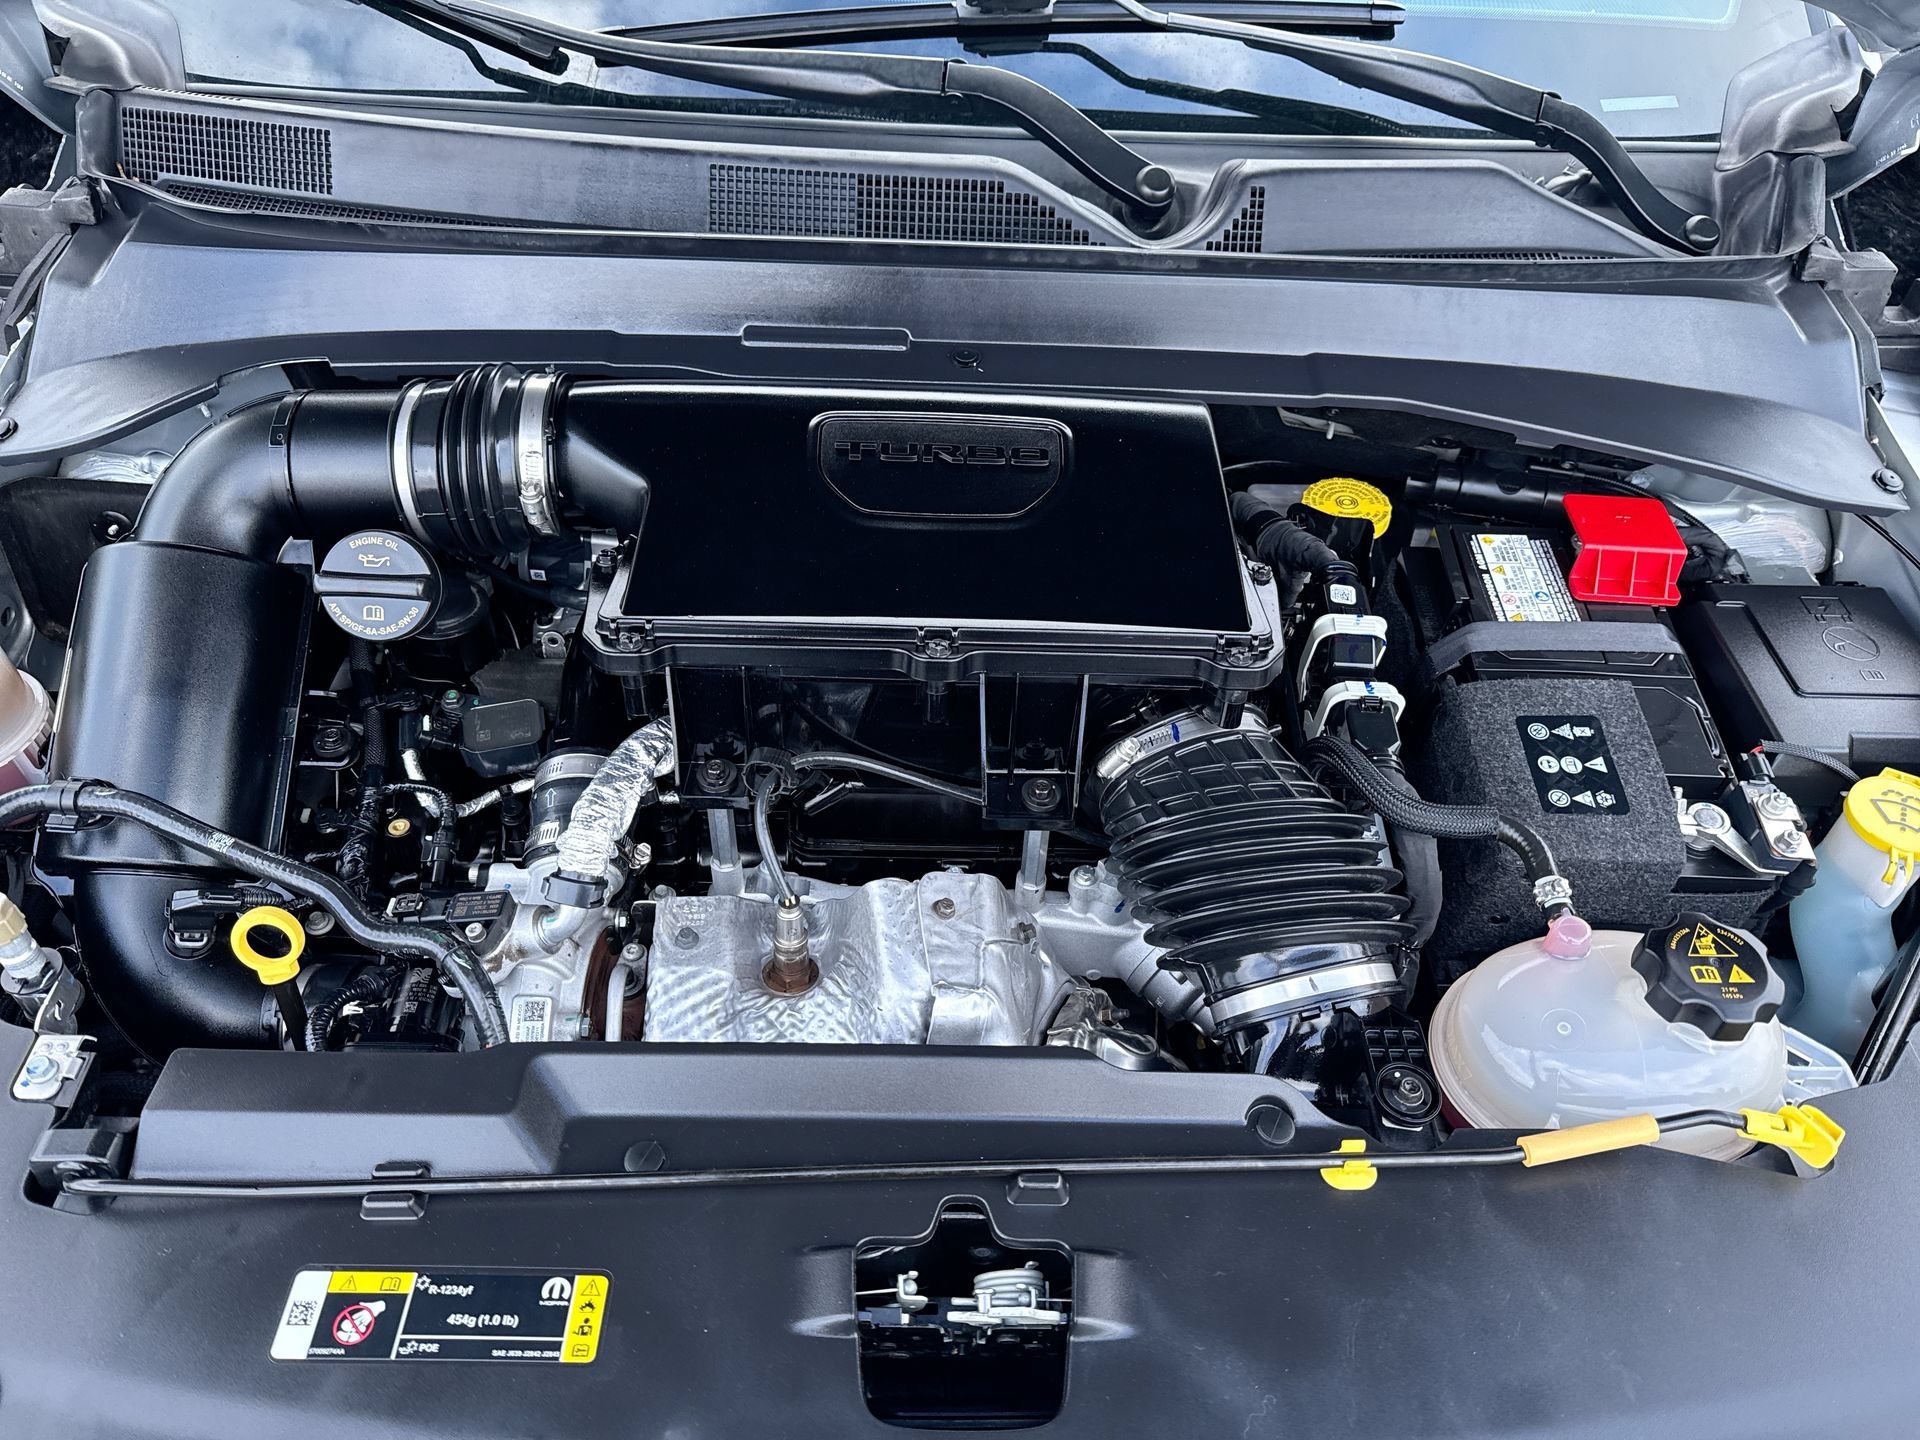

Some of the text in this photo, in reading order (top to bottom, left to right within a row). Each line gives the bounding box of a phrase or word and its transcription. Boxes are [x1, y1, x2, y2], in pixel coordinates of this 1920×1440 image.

[834, 441, 1051, 467] TURBO
[348, 536, 400, 552] ENGINE OIL
[328, 601, 342, 617] API
[428, 1285, 475, 1297] R-1234yf
[446, 1313, 519, 1329] 454g (1.0 lb)
[419, 1343, 440, 1353] POE
[491, 1349, 507, 1357] SAE
